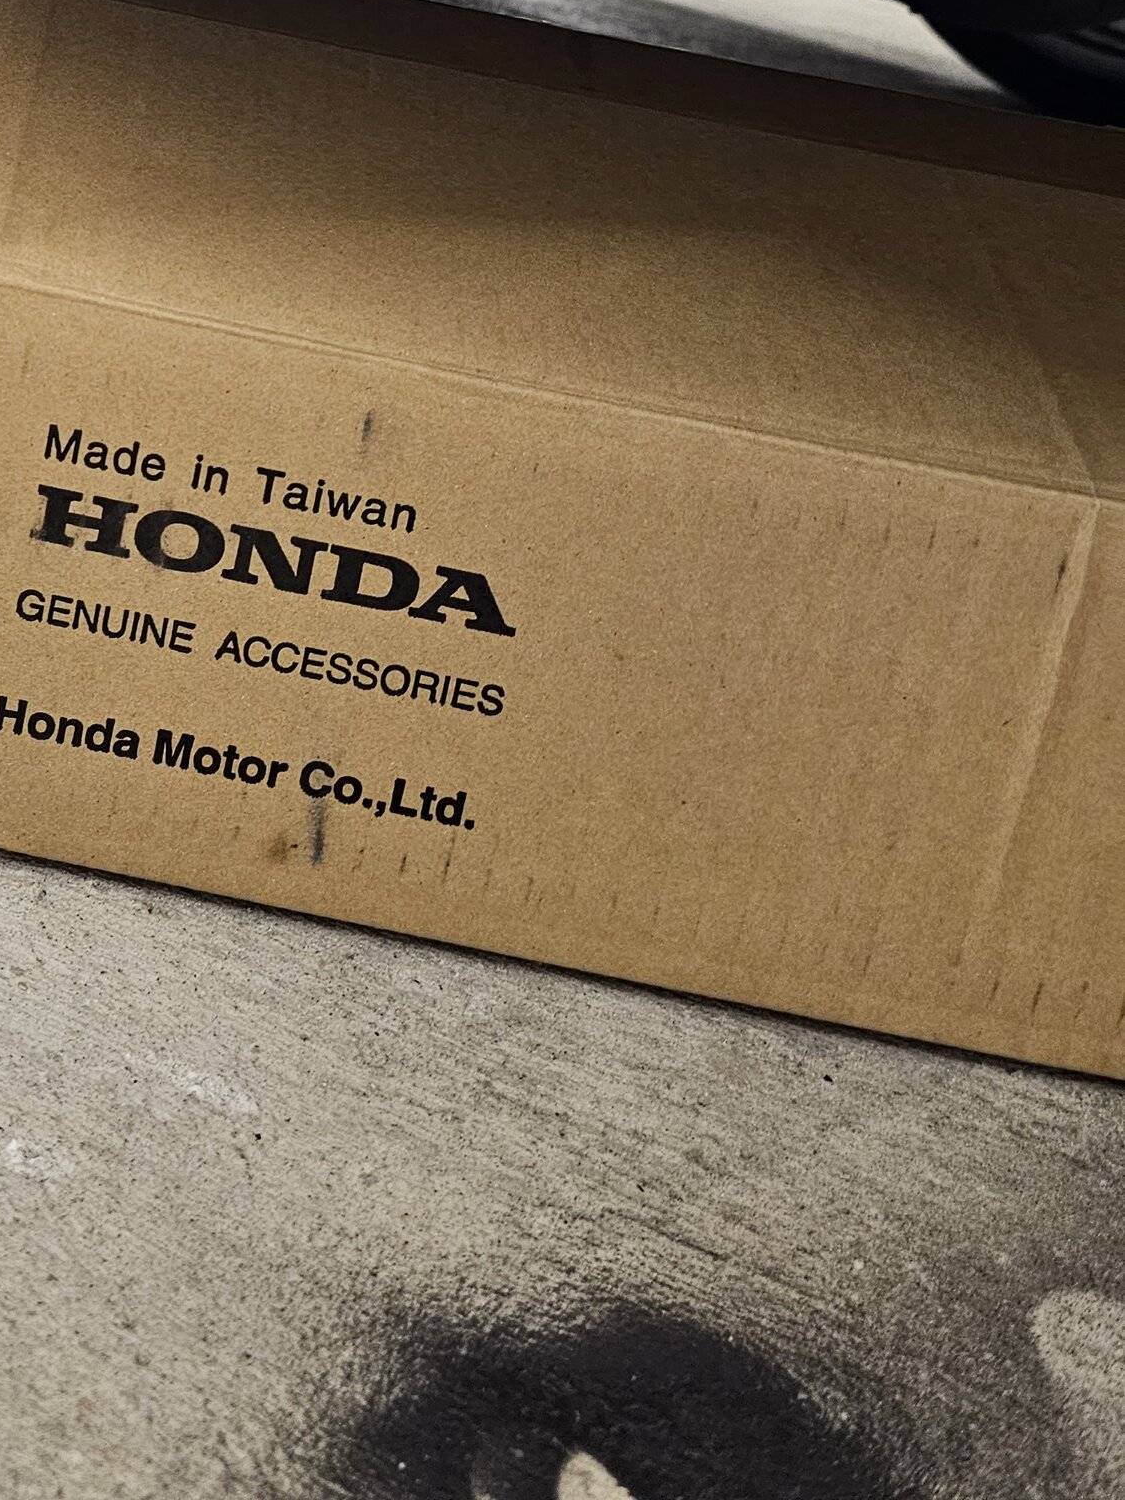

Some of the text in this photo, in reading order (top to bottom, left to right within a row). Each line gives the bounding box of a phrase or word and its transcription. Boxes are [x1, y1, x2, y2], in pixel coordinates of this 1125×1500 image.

[44, 425, 416, 533] Made in Taiwan
[30, 484, 516, 637] HONDA
[16, 590, 505, 716] GENUINE ACCESSORIES
[152, 729, 289, 788] Motor
[300, 761, 474, 830] Co.,Ltd.
